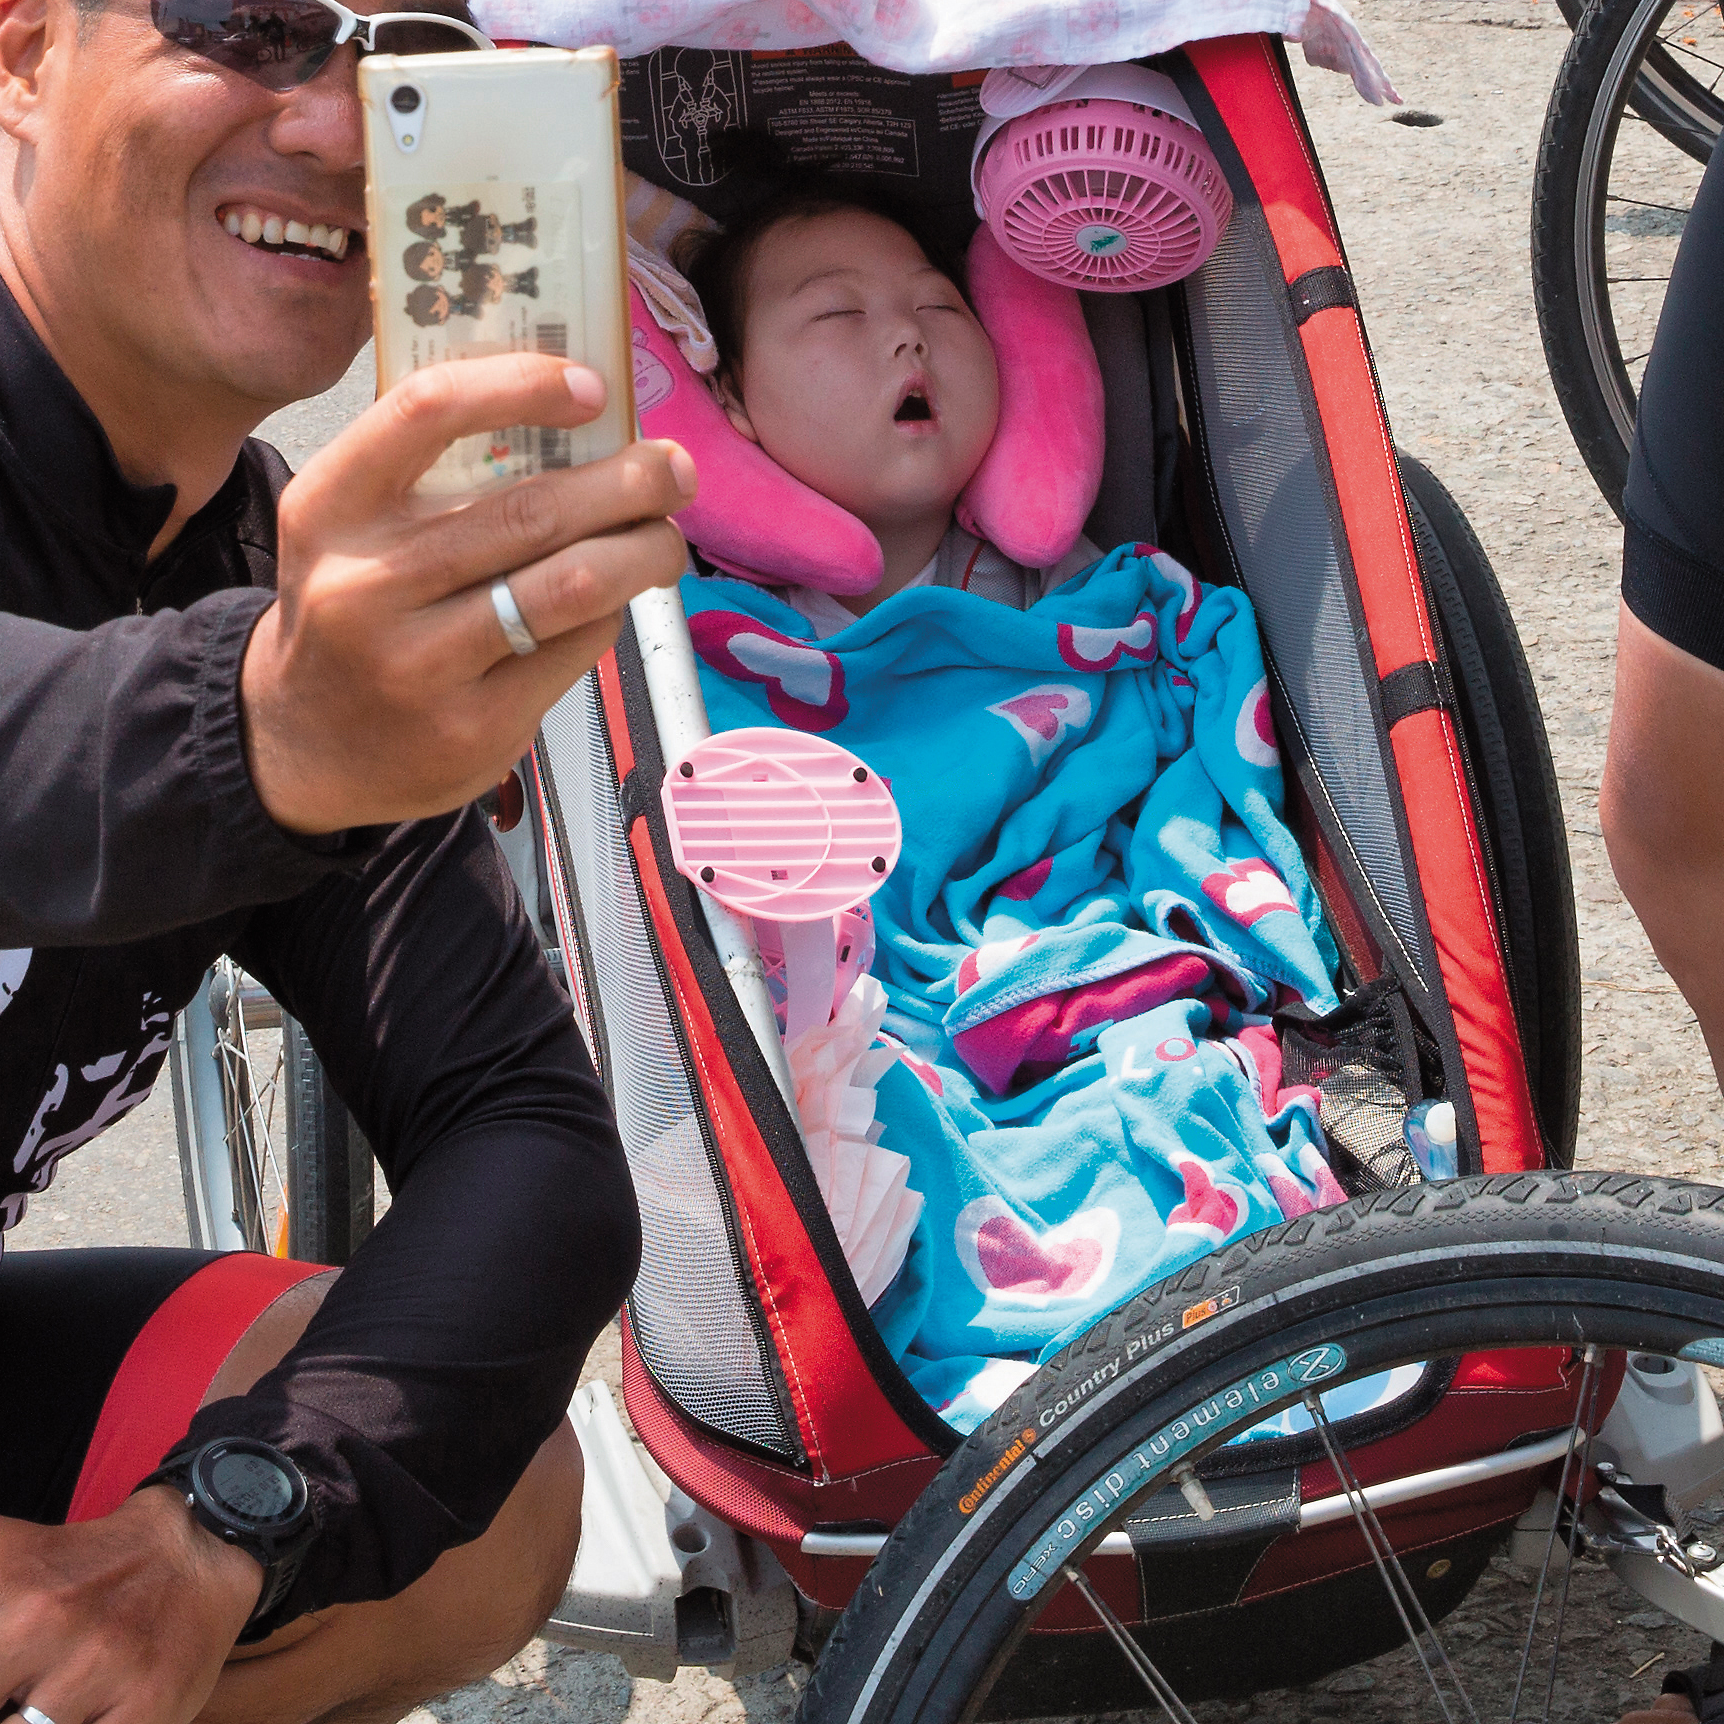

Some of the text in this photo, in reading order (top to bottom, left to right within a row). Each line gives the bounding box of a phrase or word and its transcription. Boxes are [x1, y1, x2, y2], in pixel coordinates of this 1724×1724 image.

[1185, 1306, 1207, 1325] Plus
[1039, 1322, 1176, 1429] Country Plus
[958, 1439, 1026, 1515] Continental
[1057, 1370, 1281, 1541] element disc
[1013, 1542, 1057, 1597] XERO
